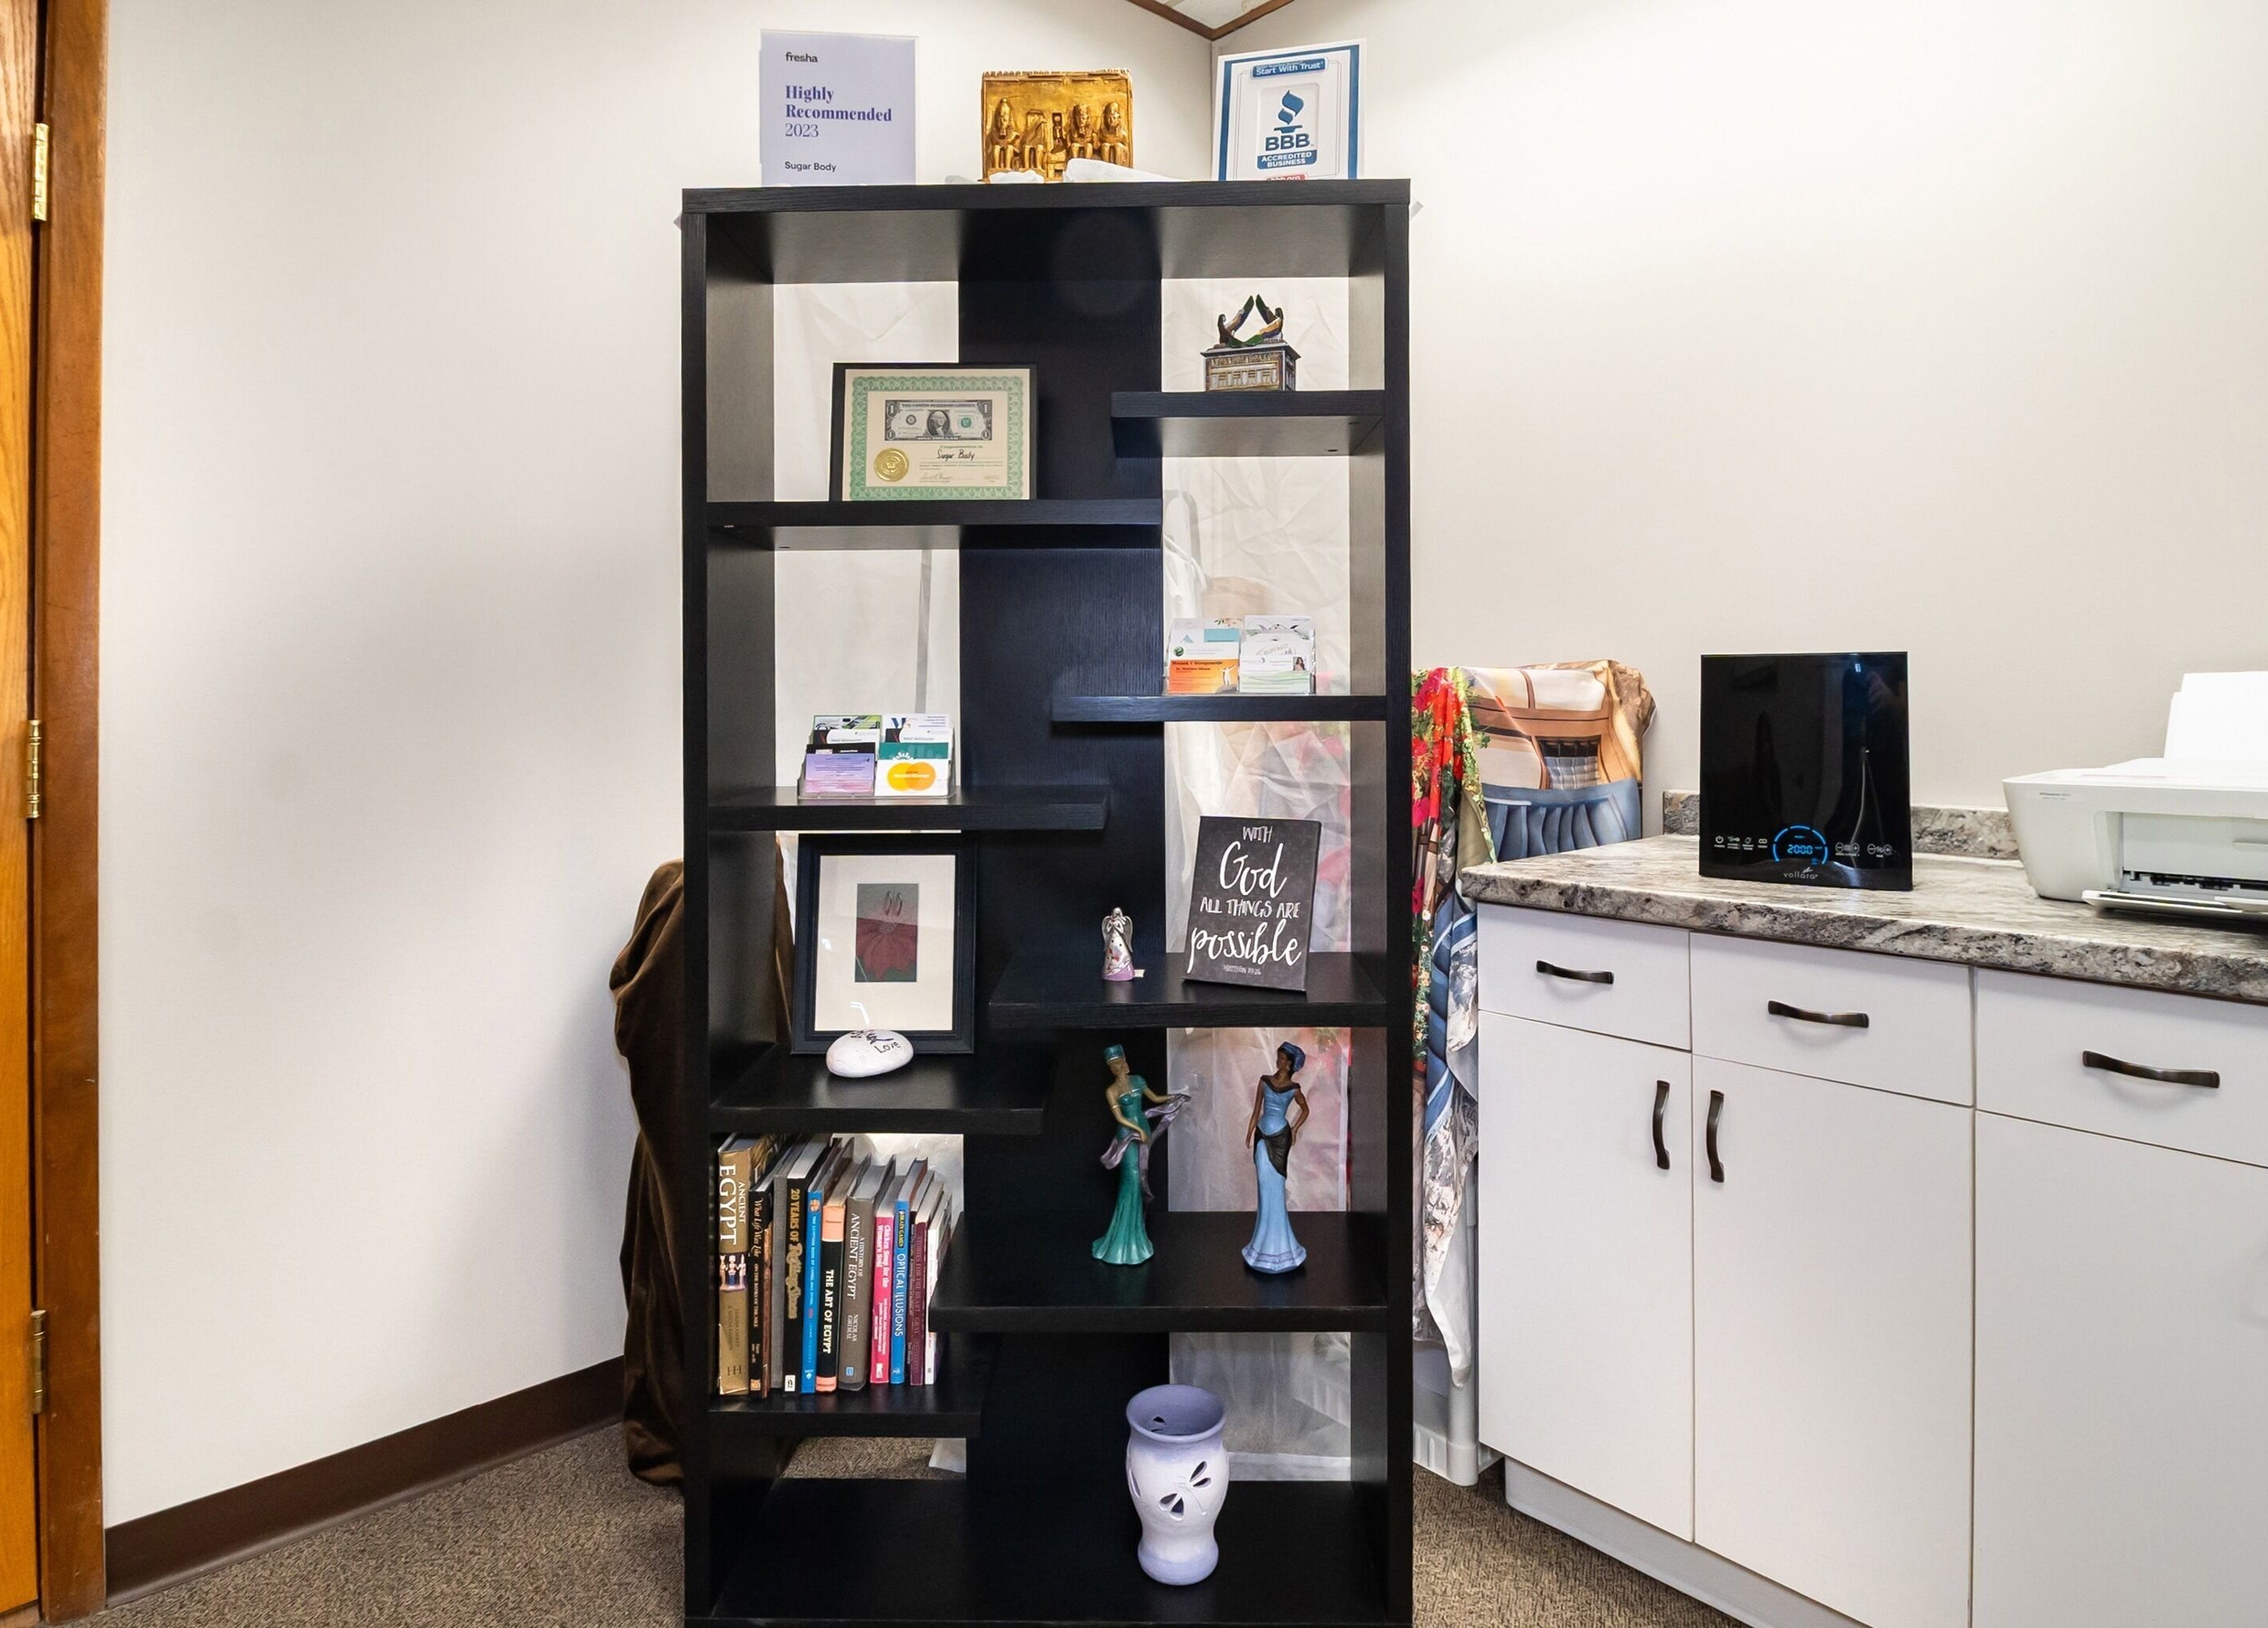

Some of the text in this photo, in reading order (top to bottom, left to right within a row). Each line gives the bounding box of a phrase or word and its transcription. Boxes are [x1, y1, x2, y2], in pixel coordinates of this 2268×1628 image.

[785, 52, 818, 63] fresha
[1256, 62, 1320, 76] Start With Trust
[785, 85, 834, 103] Highly
[785, 104, 892, 122] Recommended
[785, 123, 819, 137] 2023
[1265, 133, 1310, 151] BBB
[1261, 152, 1312, 163] ACCREDITED
[1267, 158, 1306, 167] BUSINESS
[784, 161, 836, 173] Sugar Body
[937, 448, 975, 462] Sugar Body
[1242, 825, 1273, 844] WITH
[1786, 844, 1813, 855] 2000
[1219, 841, 1287, 898] God
[1200, 897, 1301, 919] ALL THINGS ARE
[1187, 919, 1302, 974] possible
[874, 1041, 901, 1053] Love
[790, 1189, 800, 1200] 20
[719, 1164, 737, 1245] EGYPT
[790, 1201, 800, 1229] YEARS
[751, 1198, 764, 1258] What Life Was Like
[790, 1231, 799, 1242] OF
[847, 1213, 860, 1299] ANCIENT EGYPT
[894, 1253, 906, 1337] OPTICAL ILLUSIONS
[822, 1269, 835, 1354] THE ART OF EGYPT
